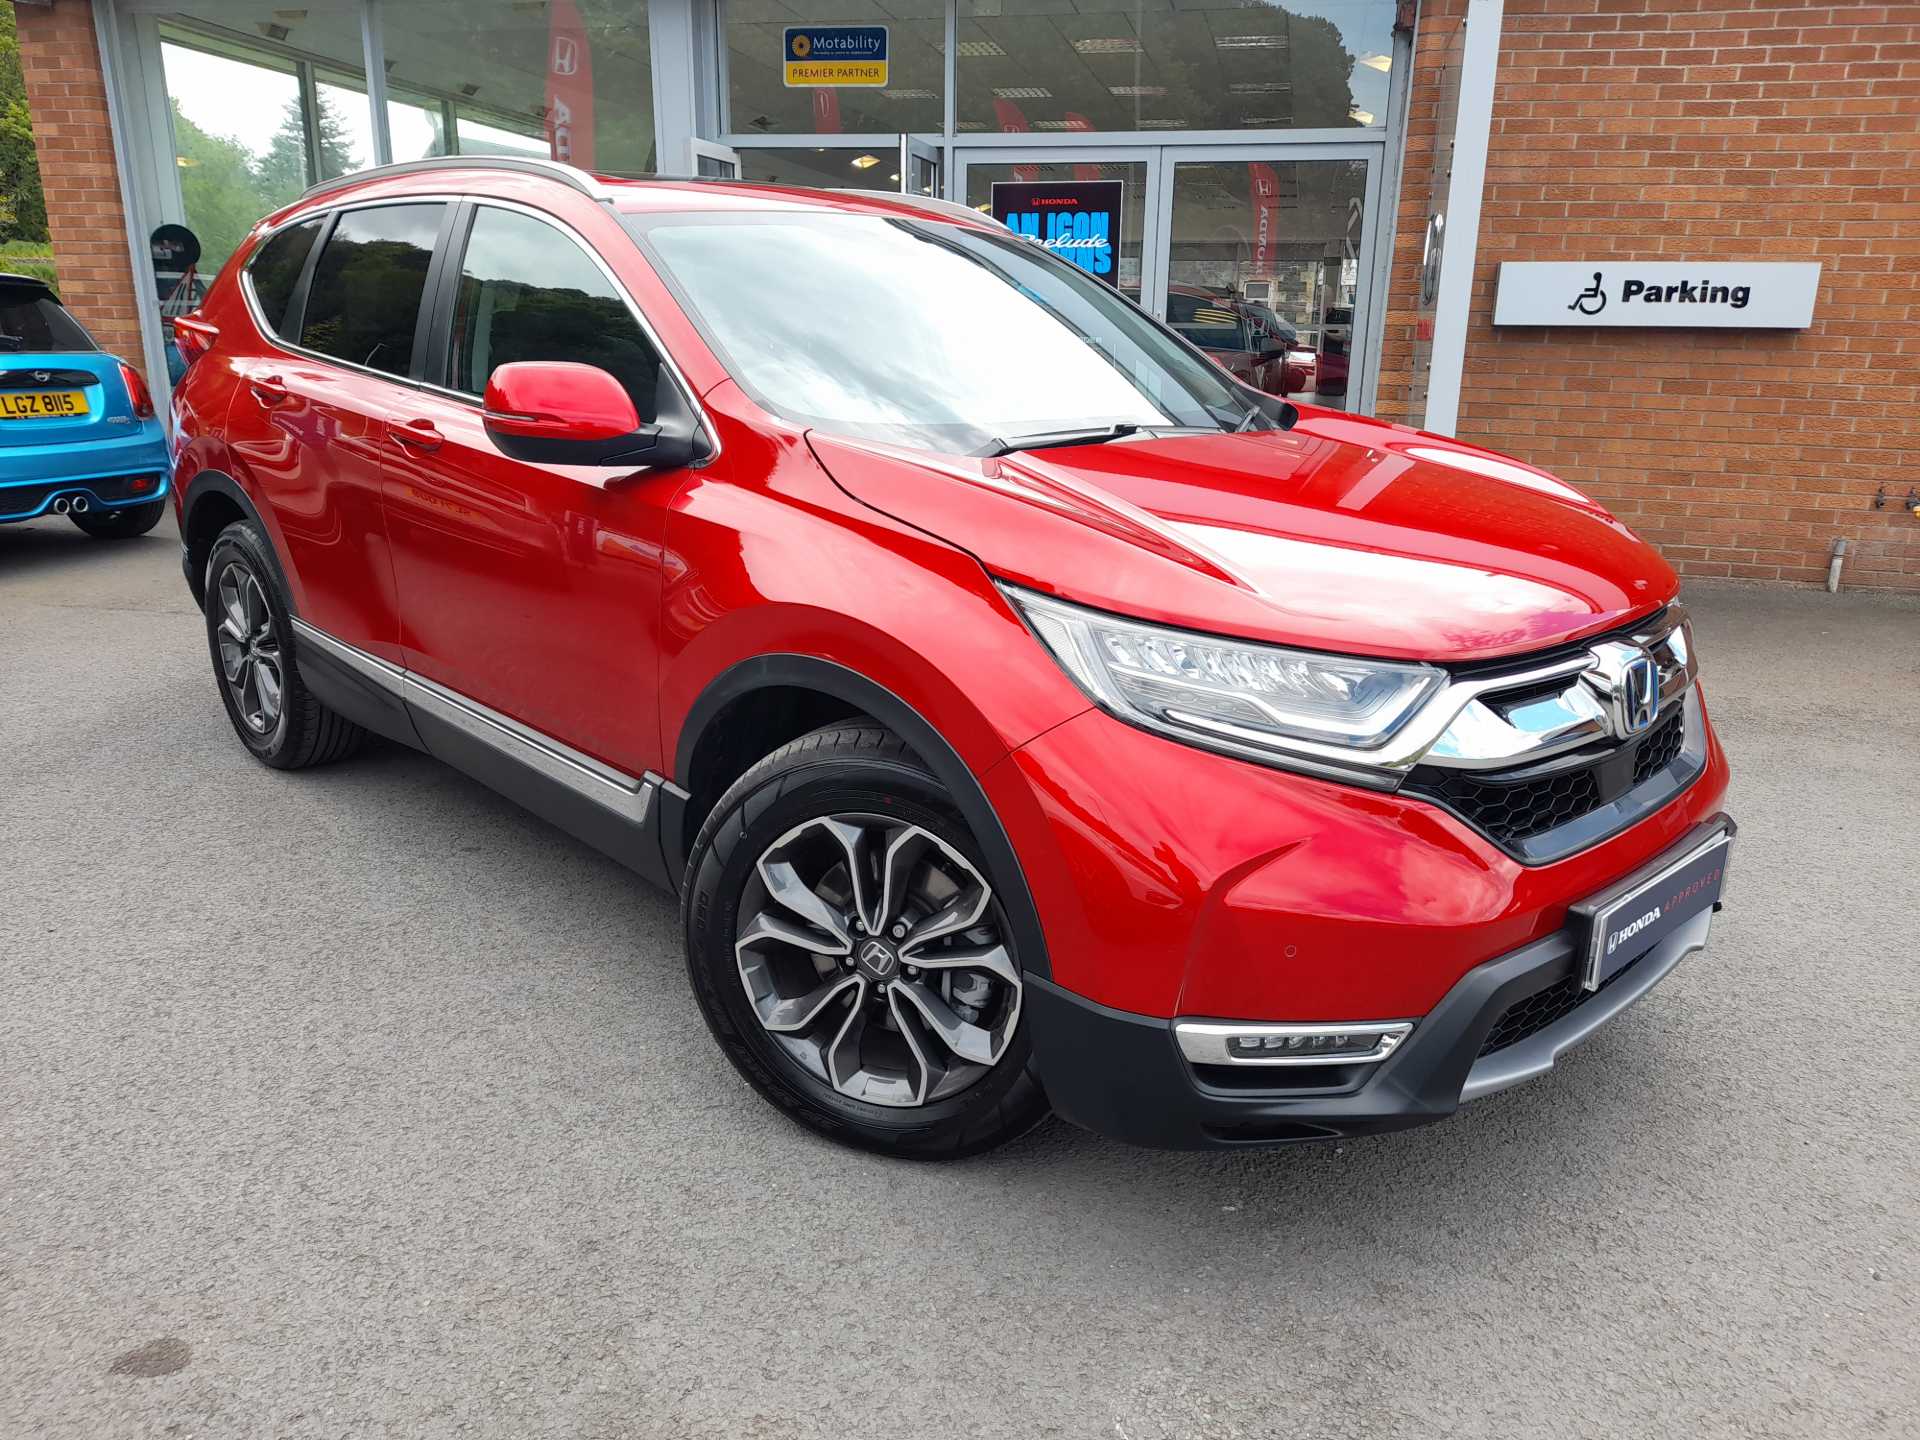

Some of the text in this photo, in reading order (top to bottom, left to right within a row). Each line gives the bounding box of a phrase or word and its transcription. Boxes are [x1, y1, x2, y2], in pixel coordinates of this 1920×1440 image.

[812, 35, 881, 52] Motability
[792, 67, 880, 78] PREMIER PARTNER
[1007, 211, 1109, 240] AN ICON
[1621, 280, 1751, 309] Parking
[1, 394, 74, 414] LGZ 8115
[1617, 868, 1721, 945] HONDA APPROVED
